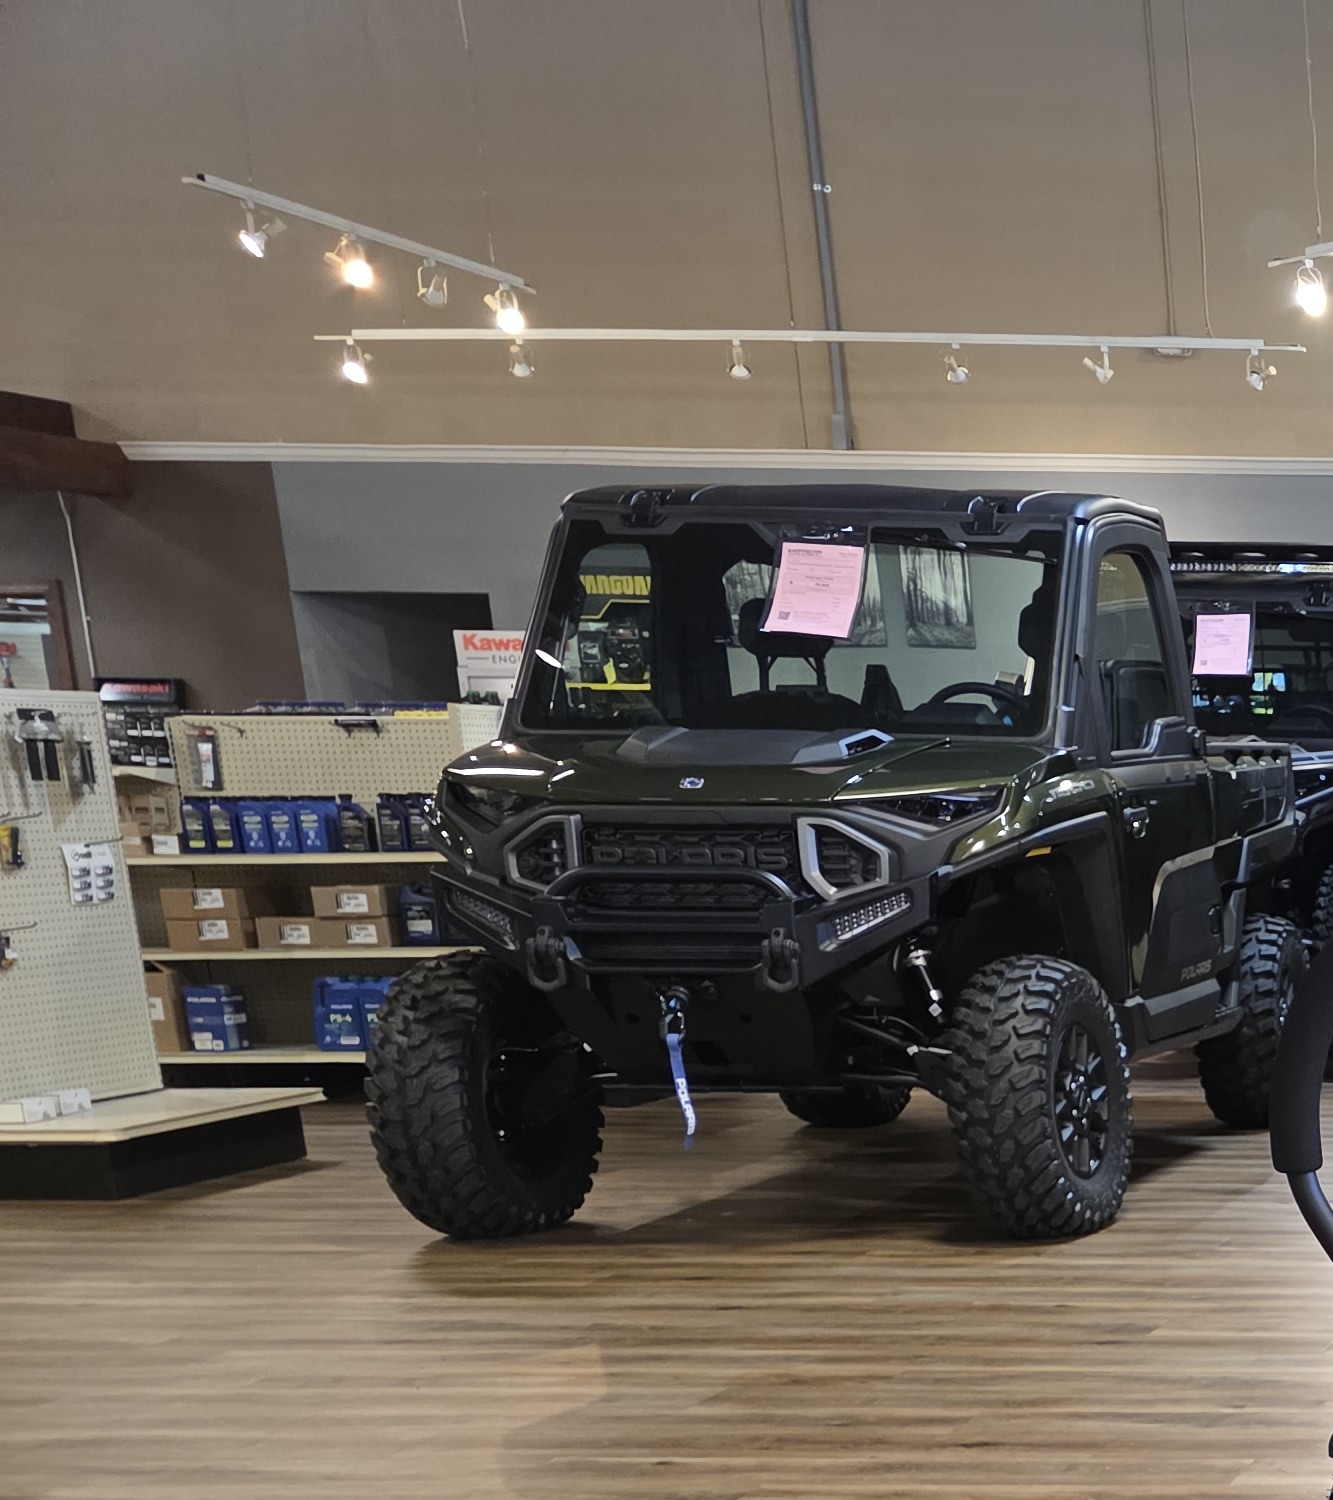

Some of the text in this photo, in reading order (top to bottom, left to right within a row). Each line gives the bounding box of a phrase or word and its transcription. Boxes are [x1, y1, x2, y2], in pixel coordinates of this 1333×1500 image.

[462, 633, 522, 651] Kawa
[491, 655, 521, 664] ENG
[675, 1077, 697, 1136] POLARIS
